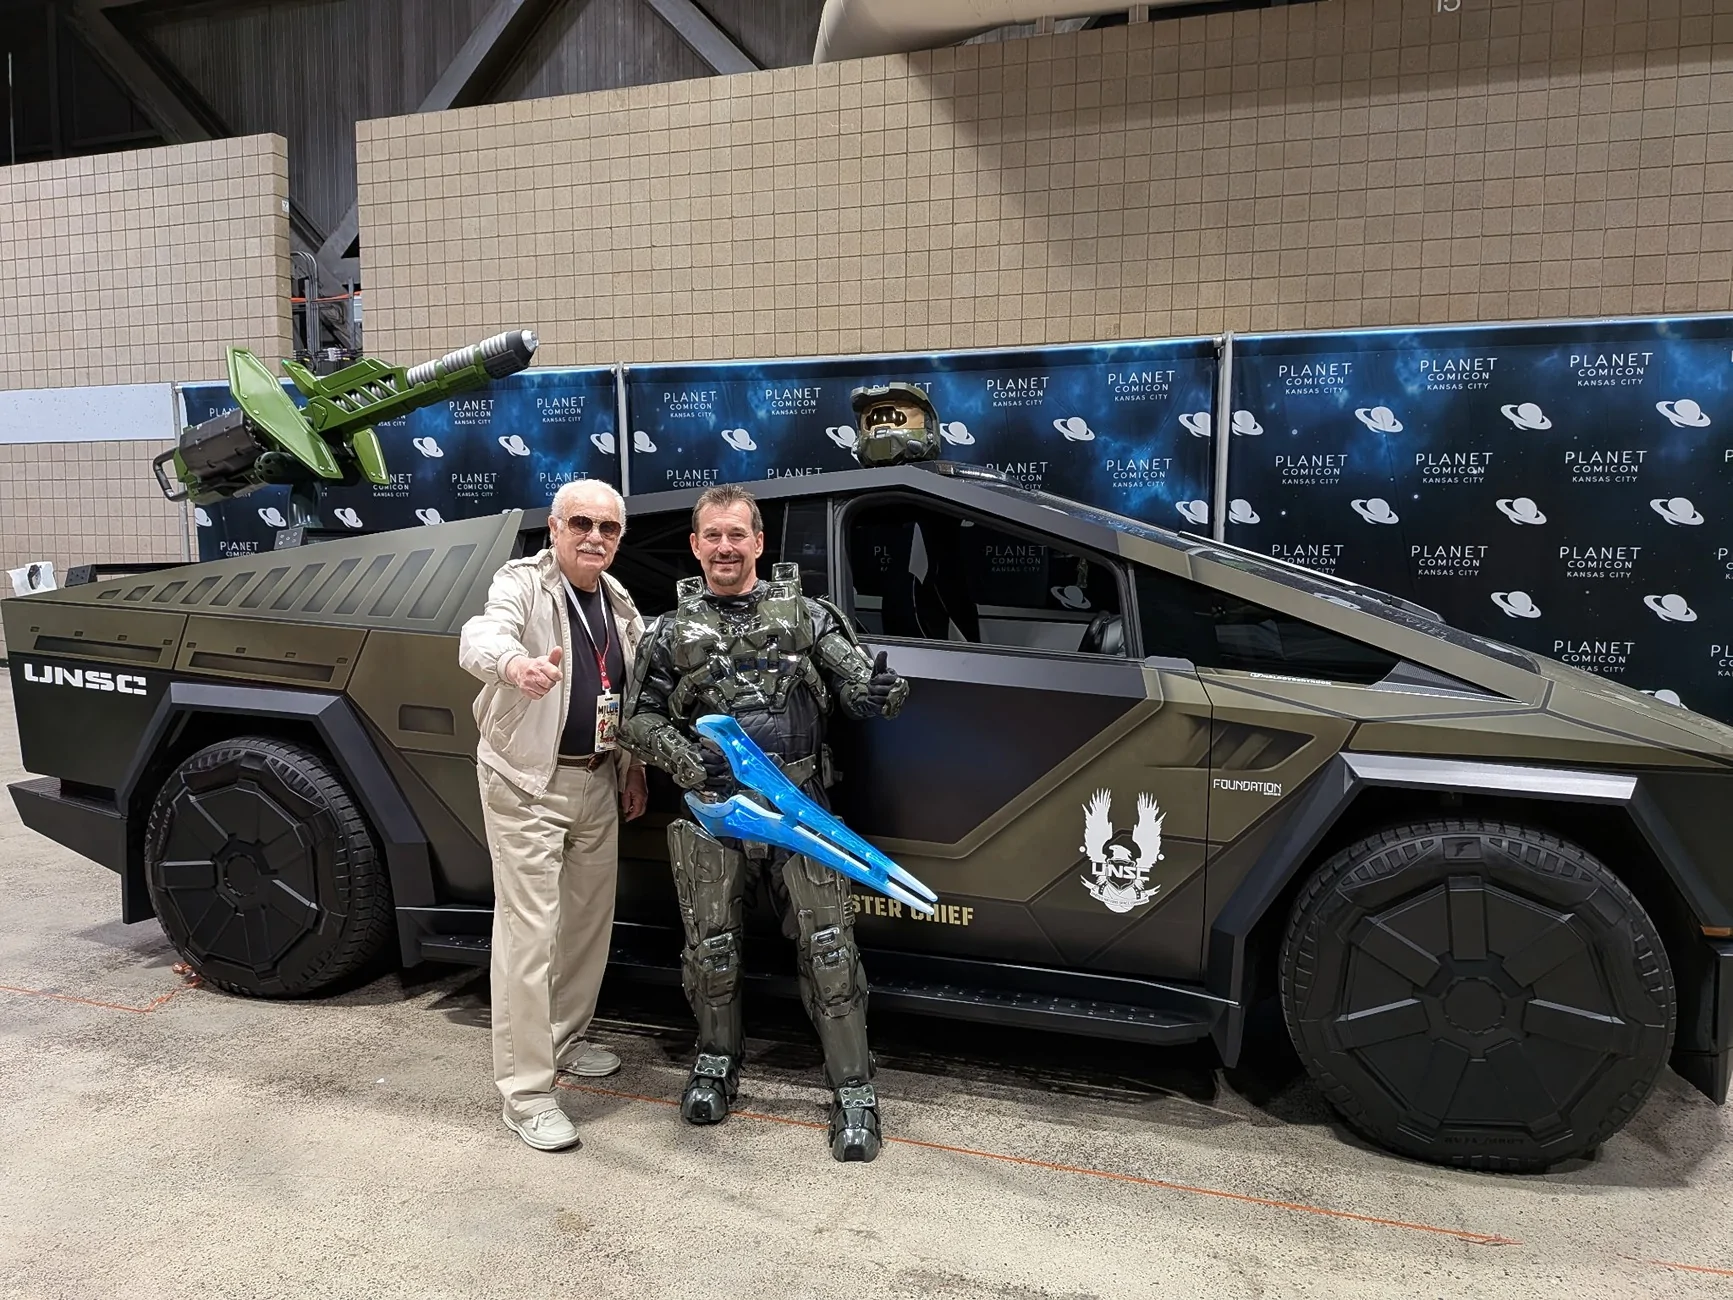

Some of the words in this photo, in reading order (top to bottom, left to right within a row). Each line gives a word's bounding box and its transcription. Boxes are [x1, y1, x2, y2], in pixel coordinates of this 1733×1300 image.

[1420, 357, 1498, 373] PLANET
[1570, 352, 1653, 368] PLANET
[1278, 362, 1352, 377] PLANET
[1578, 367, 1644, 377] COMICON
[1108, 370, 1175, 385] PLANET
[1286, 377, 1344, 386] COMICON
[1427, 372, 1490, 381] COMICON
[986, 376, 1050, 391] PLANET
[1427, 383, 1463, 391] KANSAS
[1577, 379, 1616, 387] KANSAS
[1621, 378, 1644, 386] CITY
[765, 387, 822, 400] PLANET
[1115, 384, 1169, 393] COMICON
[1285, 387, 1320, 395] KANSAS
[663, 391, 717, 403] PLANET
[993, 390, 1044, 399] COMICON
[449, 400, 495, 411] PLANET
[536, 396, 586, 408] PLANET
[771, 400, 817, 408] COMICON
[1275, 454, 1348, 467] PLANET
[1415, 452, 1494, 466] PLANET
[1564, 450, 1648, 464] PLANET
[1106, 458, 1173, 471] PLANET
[1572, 465, 1639, 473] COMICON
[666, 469, 719, 480] PLANET
[767, 467, 823, 479] PLANET
[1112, 471, 1166, 479] COMICON
[1282, 467, 1341, 476] COMICON
[1423, 466, 1485, 475] COMICON
[389, 473, 414, 484] NET
[452, 472, 497, 483] PLANET
[1462, 476, 1484, 484] CITY
[220, 541, 259, 551] PLANET
[986, 545, 1048, 556] PLANET
[1272, 544, 1345, 557] PLANET
[1411, 545, 1489, 558] PLANET
[1559, 546, 1642, 560] PLANET
[992, 557, 1041, 565] COMICON
[1418, 558, 1480, 567] COMICON
[1567, 560, 1632, 569] COMICON
[1553, 640, 1636, 655] PLANET
[1561, 654, 1626, 664] COMICON
[24, 663, 147, 696] UNSC
[1213, 778, 1282, 794] FOUNDATION
[1091, 862, 1150, 882] UNSC
[851, 894, 902, 918] STER
[910, 904, 974, 926] CHIEF
